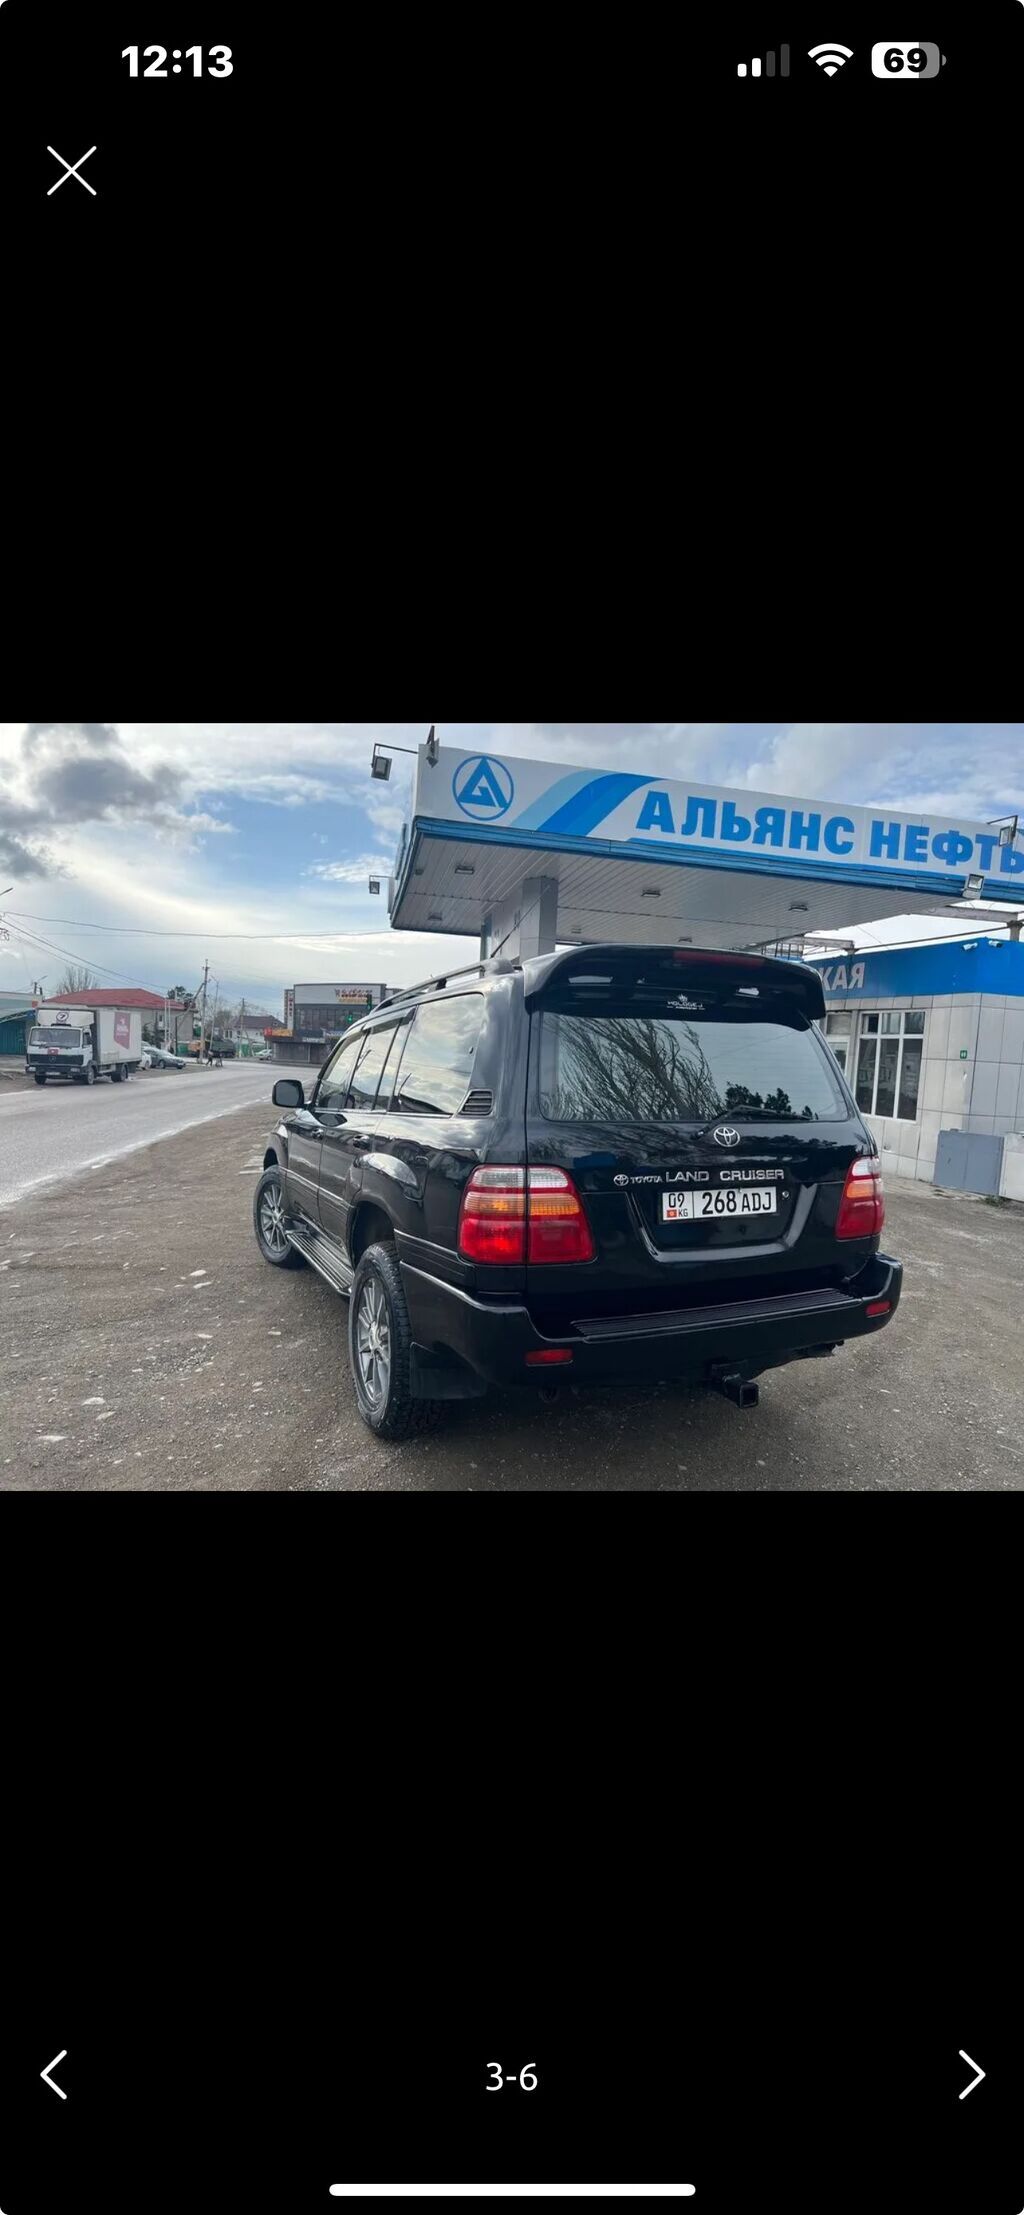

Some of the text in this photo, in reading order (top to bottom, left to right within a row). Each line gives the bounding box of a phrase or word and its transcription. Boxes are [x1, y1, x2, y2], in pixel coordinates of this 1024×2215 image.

[635, 790, 1024, 874] АЛЬЯНС НЕФТЬ
[630, 1169, 785, 1184] TOYOTA LAND CRUISER
[668, 1190, 772, 1215] 09 268 ADJ
[678, 1209, 688, 1217] KG
